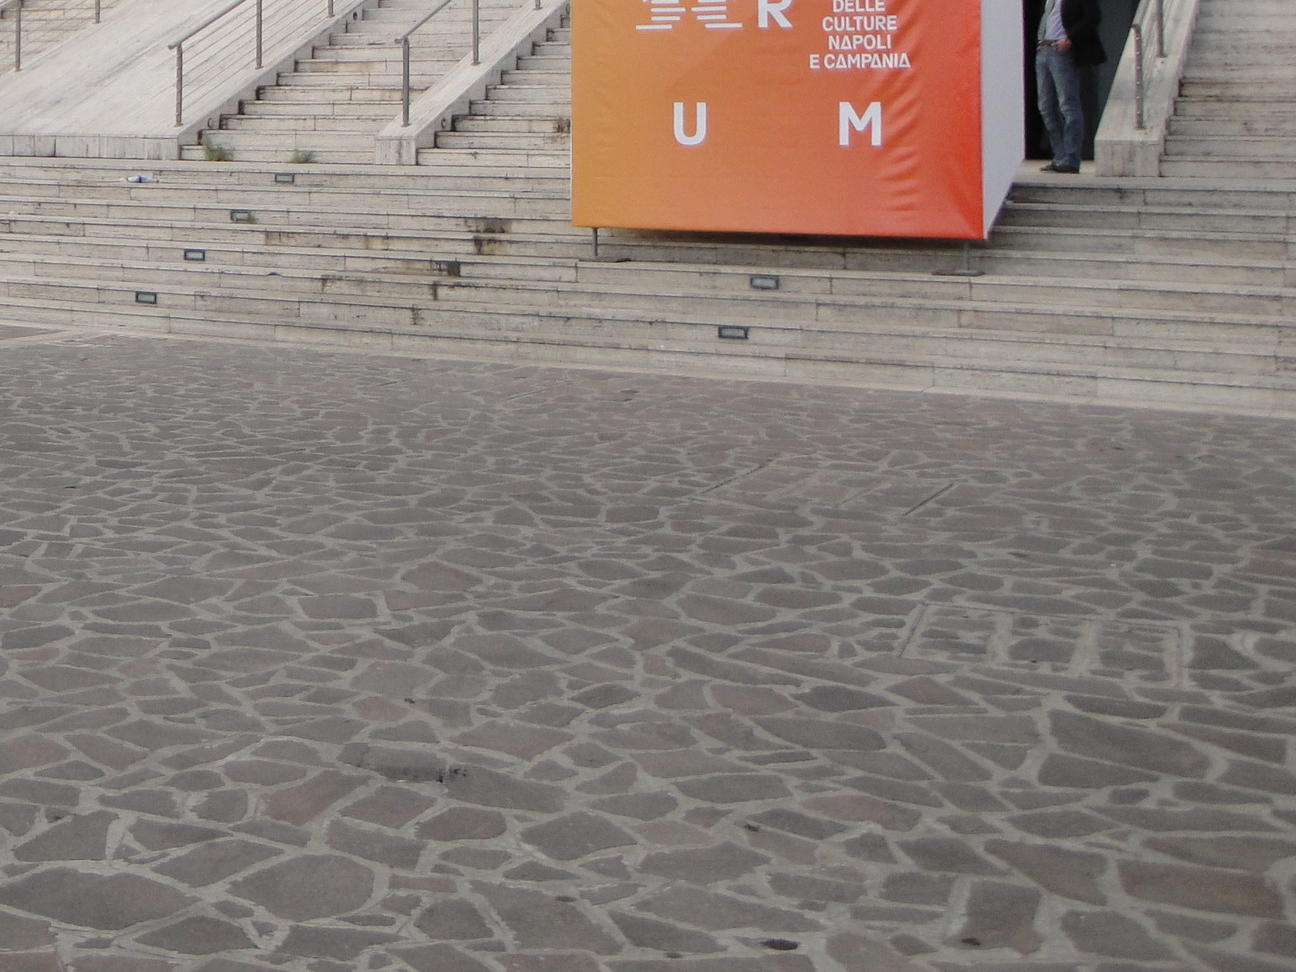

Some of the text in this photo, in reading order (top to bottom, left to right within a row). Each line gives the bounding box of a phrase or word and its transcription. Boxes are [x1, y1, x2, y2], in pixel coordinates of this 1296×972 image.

[822, 15, 898, 33] CULTURE
[828, 33, 892, 51] NAPOLI
[809, 52, 911, 70] E CAMPANIA
[673, 101, 882, 148] U M
